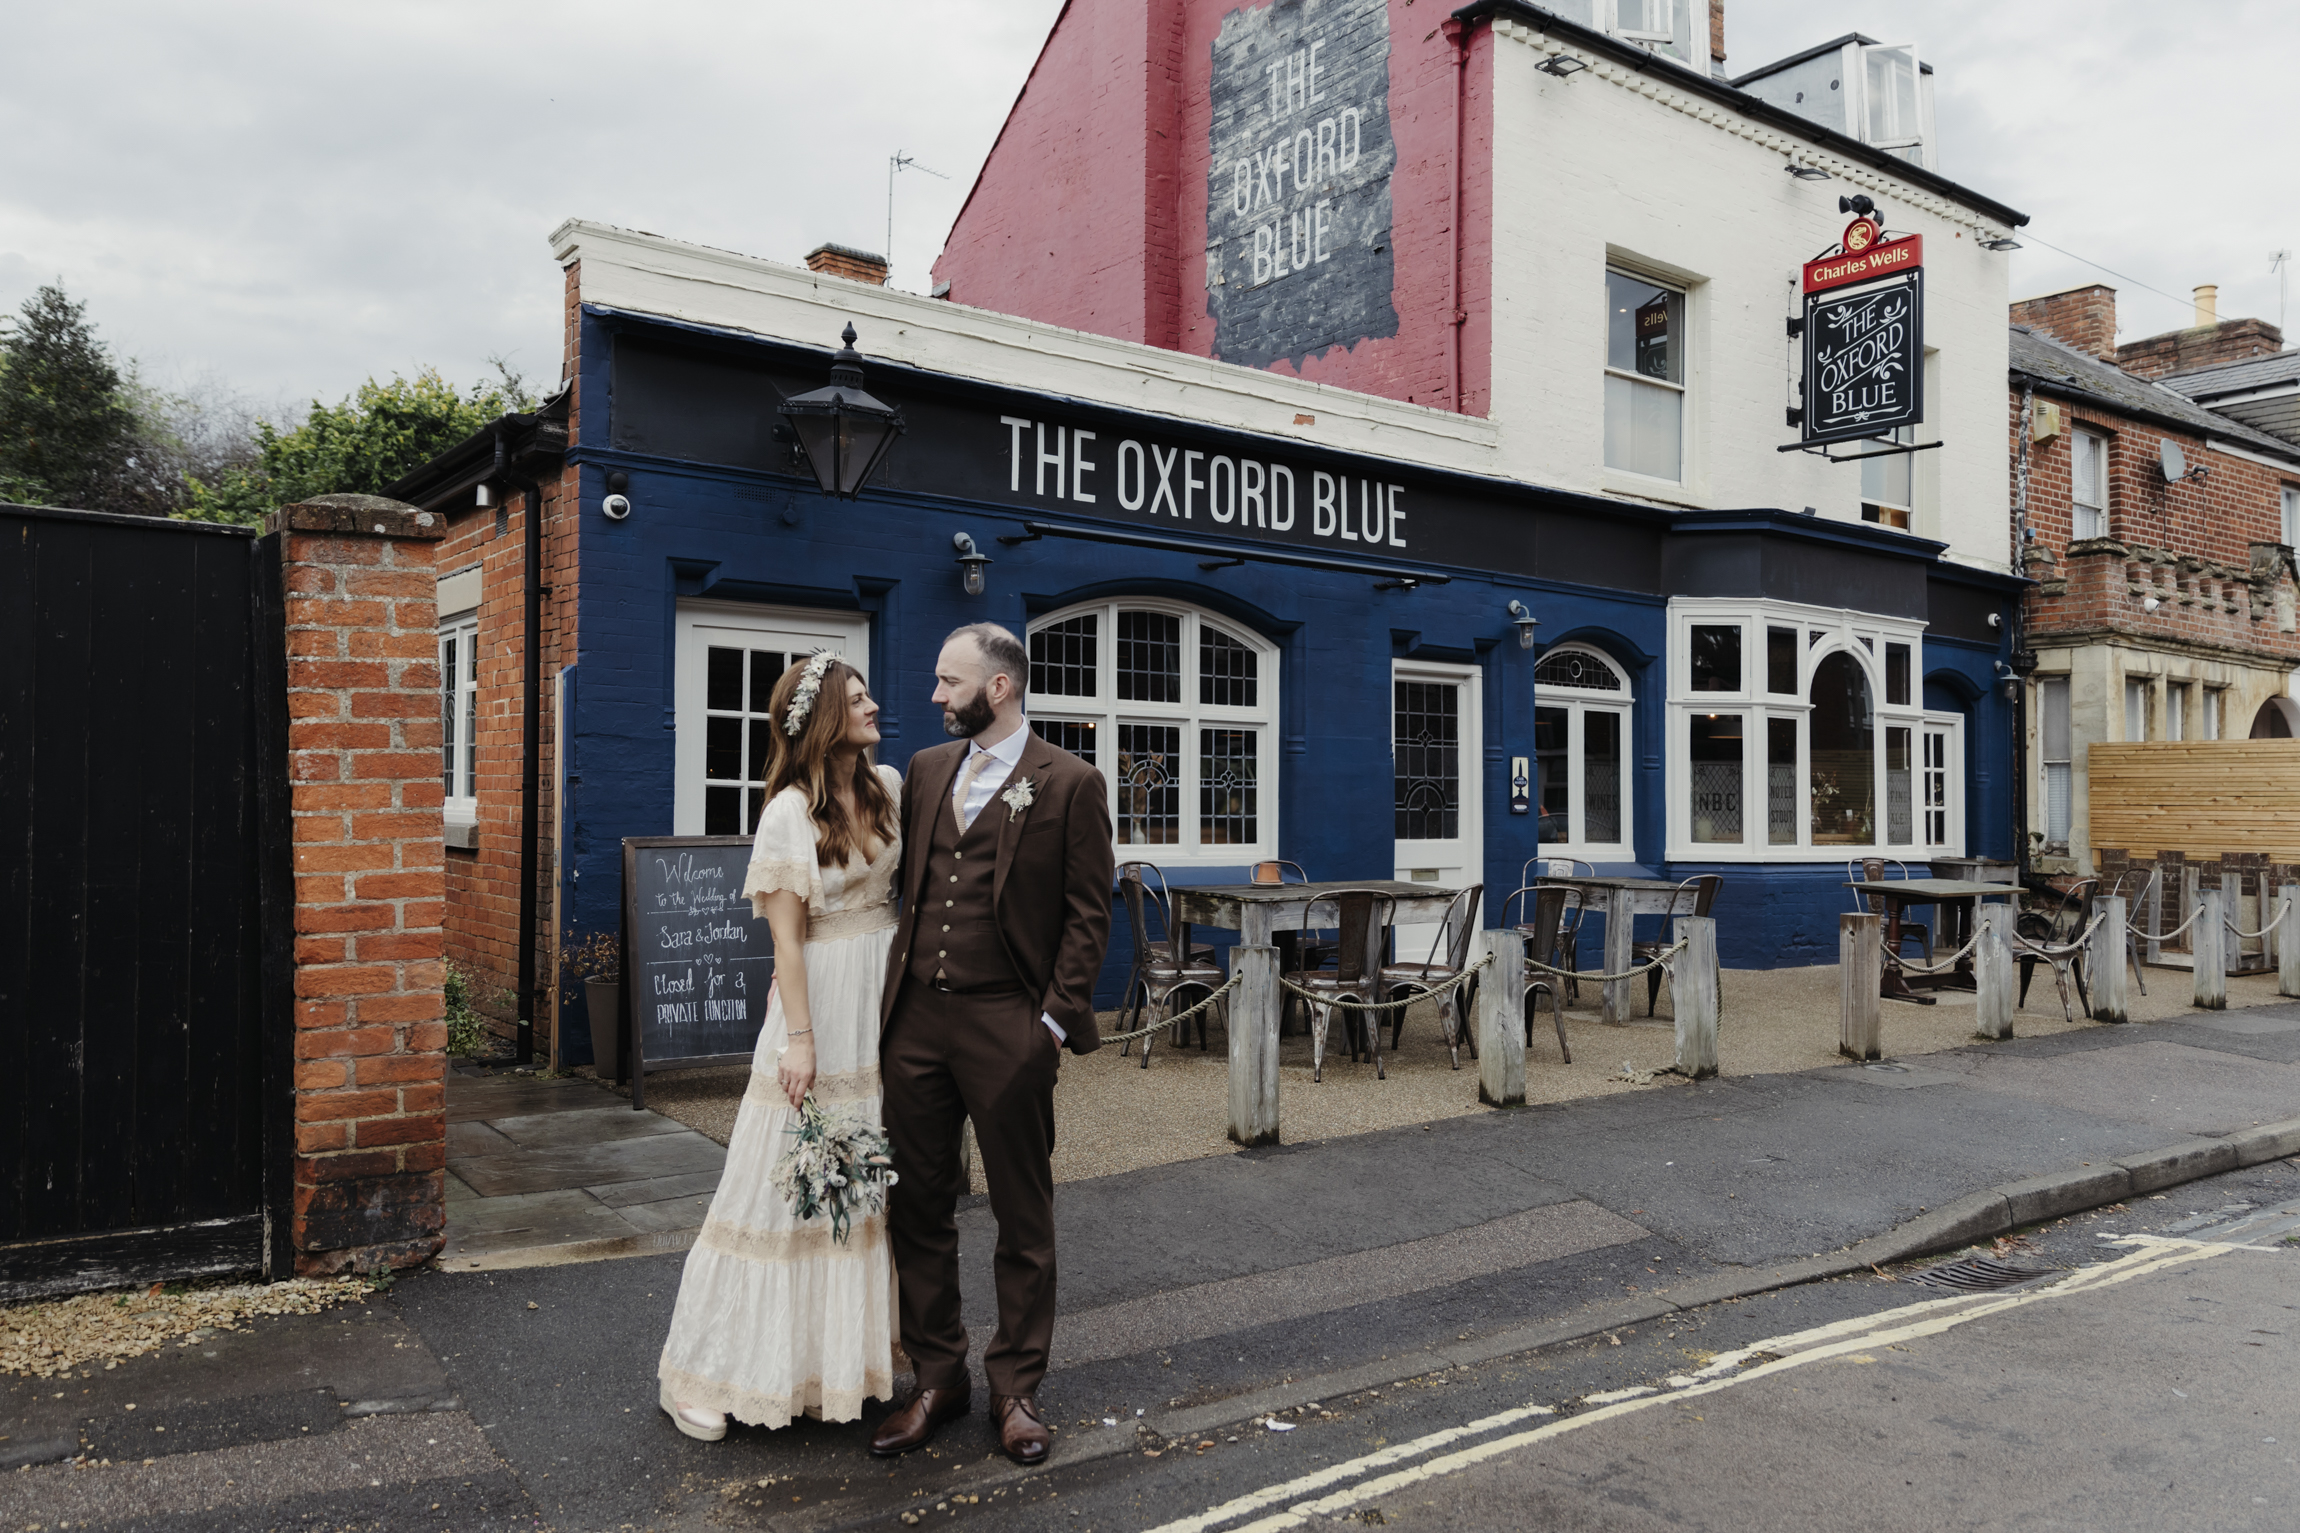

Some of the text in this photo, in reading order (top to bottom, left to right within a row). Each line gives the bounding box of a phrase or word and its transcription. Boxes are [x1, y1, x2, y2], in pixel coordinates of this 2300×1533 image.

[1266, 37, 1326, 123] THE
[1233, 106, 1361, 217] OXFORD
[1253, 198, 1331, 287] BLUE
[1813, 247, 1909, 282] Charles Wells
[1842, 304, 1877, 343] THE
[1820, 322, 1904, 392] OXFORD
[1832, 381, 1897, 414] BLUE
[1000, 414, 1407, 548] THE OXFORD BLUE
[1588, 793, 1618, 811] WINES
[1699, 793, 1736, 811] NBC
[656, 852, 724, 884] Welcome
[655, 892, 667, 906] to
[669, 891, 685, 906] the
[729, 888, 737, 904] of
[656, 919, 747, 948] Sara & Jordan
[654, 966, 746, 999] Closed for a
[657, 998, 747, 1025] PRIVATE FUNCTION
